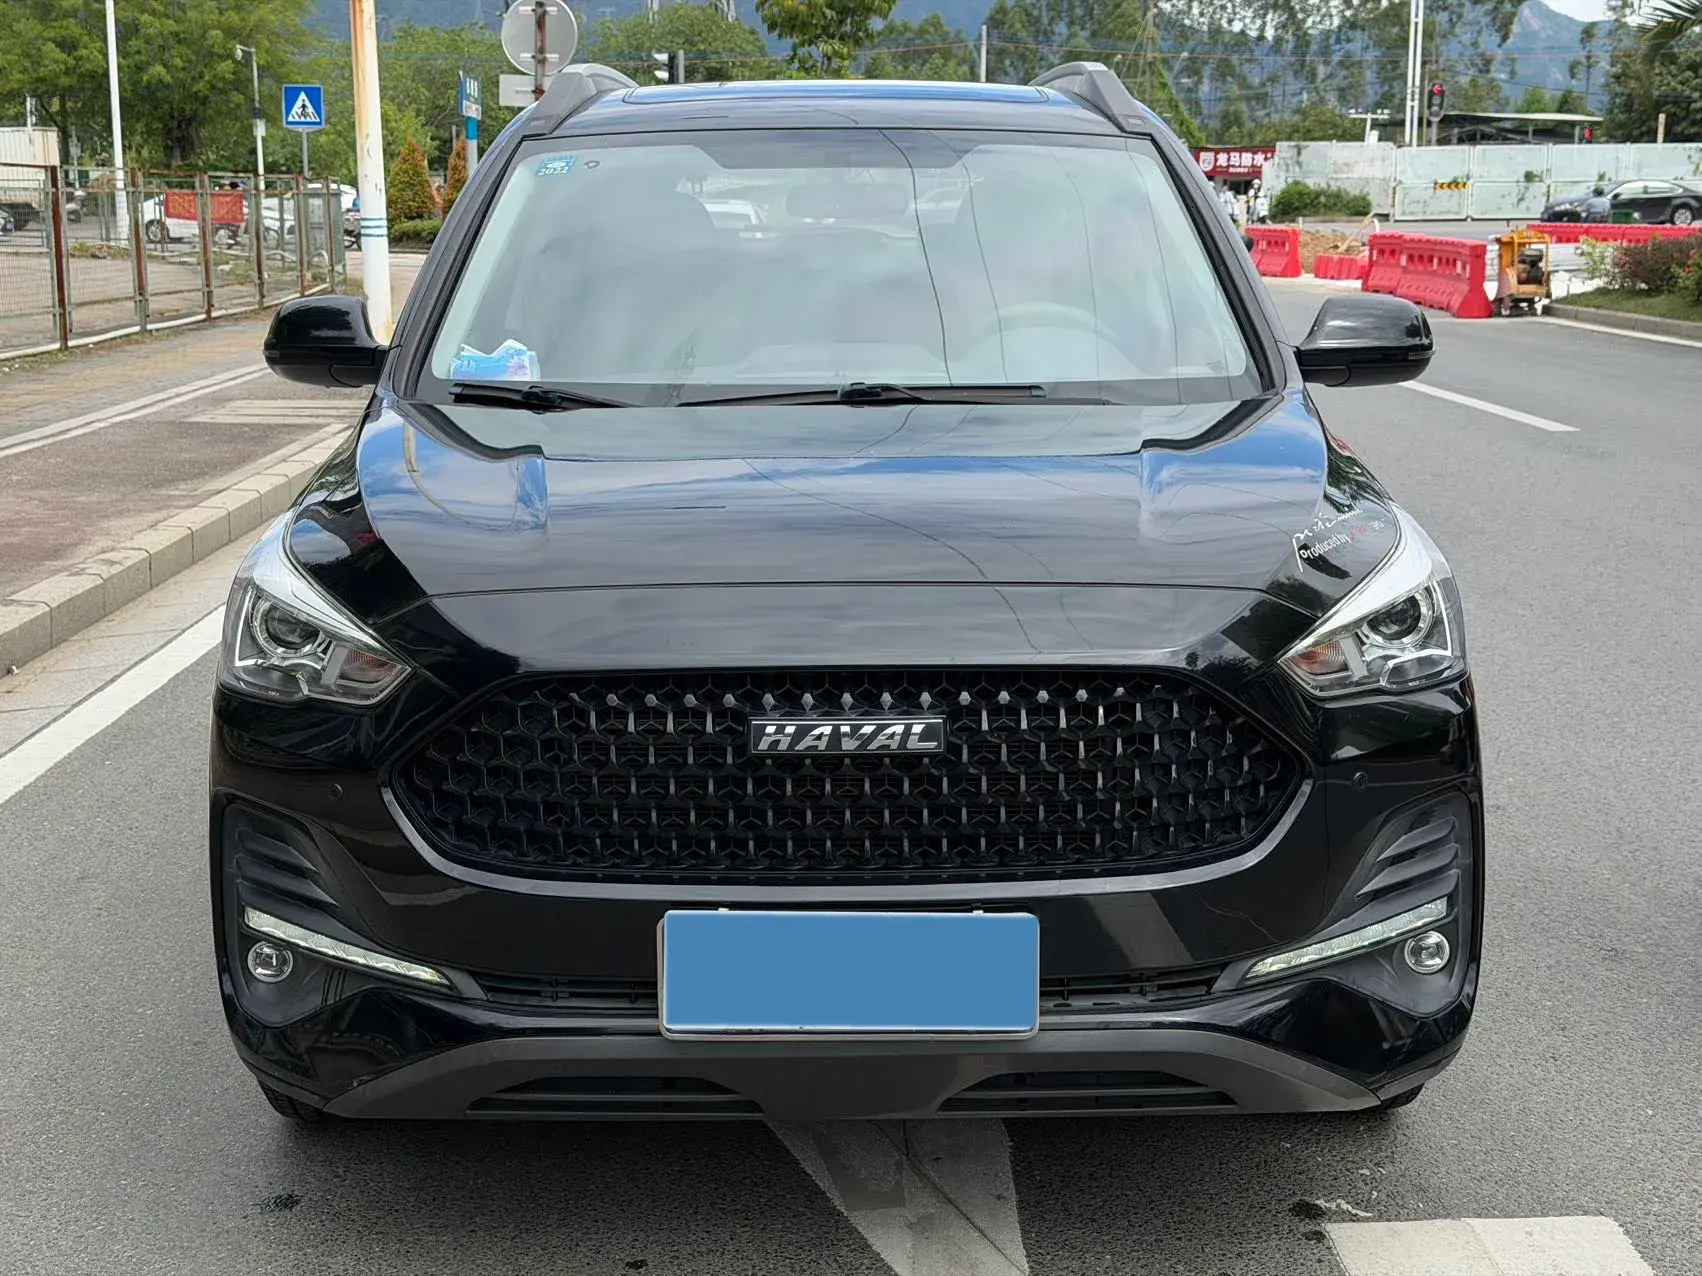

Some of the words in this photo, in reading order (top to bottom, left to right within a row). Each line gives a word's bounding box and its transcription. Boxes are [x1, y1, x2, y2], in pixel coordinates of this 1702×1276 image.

[1216, 152, 1272, 167] 龙马防水
[537, 166, 568, 176] 2022
[757, 724, 938, 751] HAVAL
